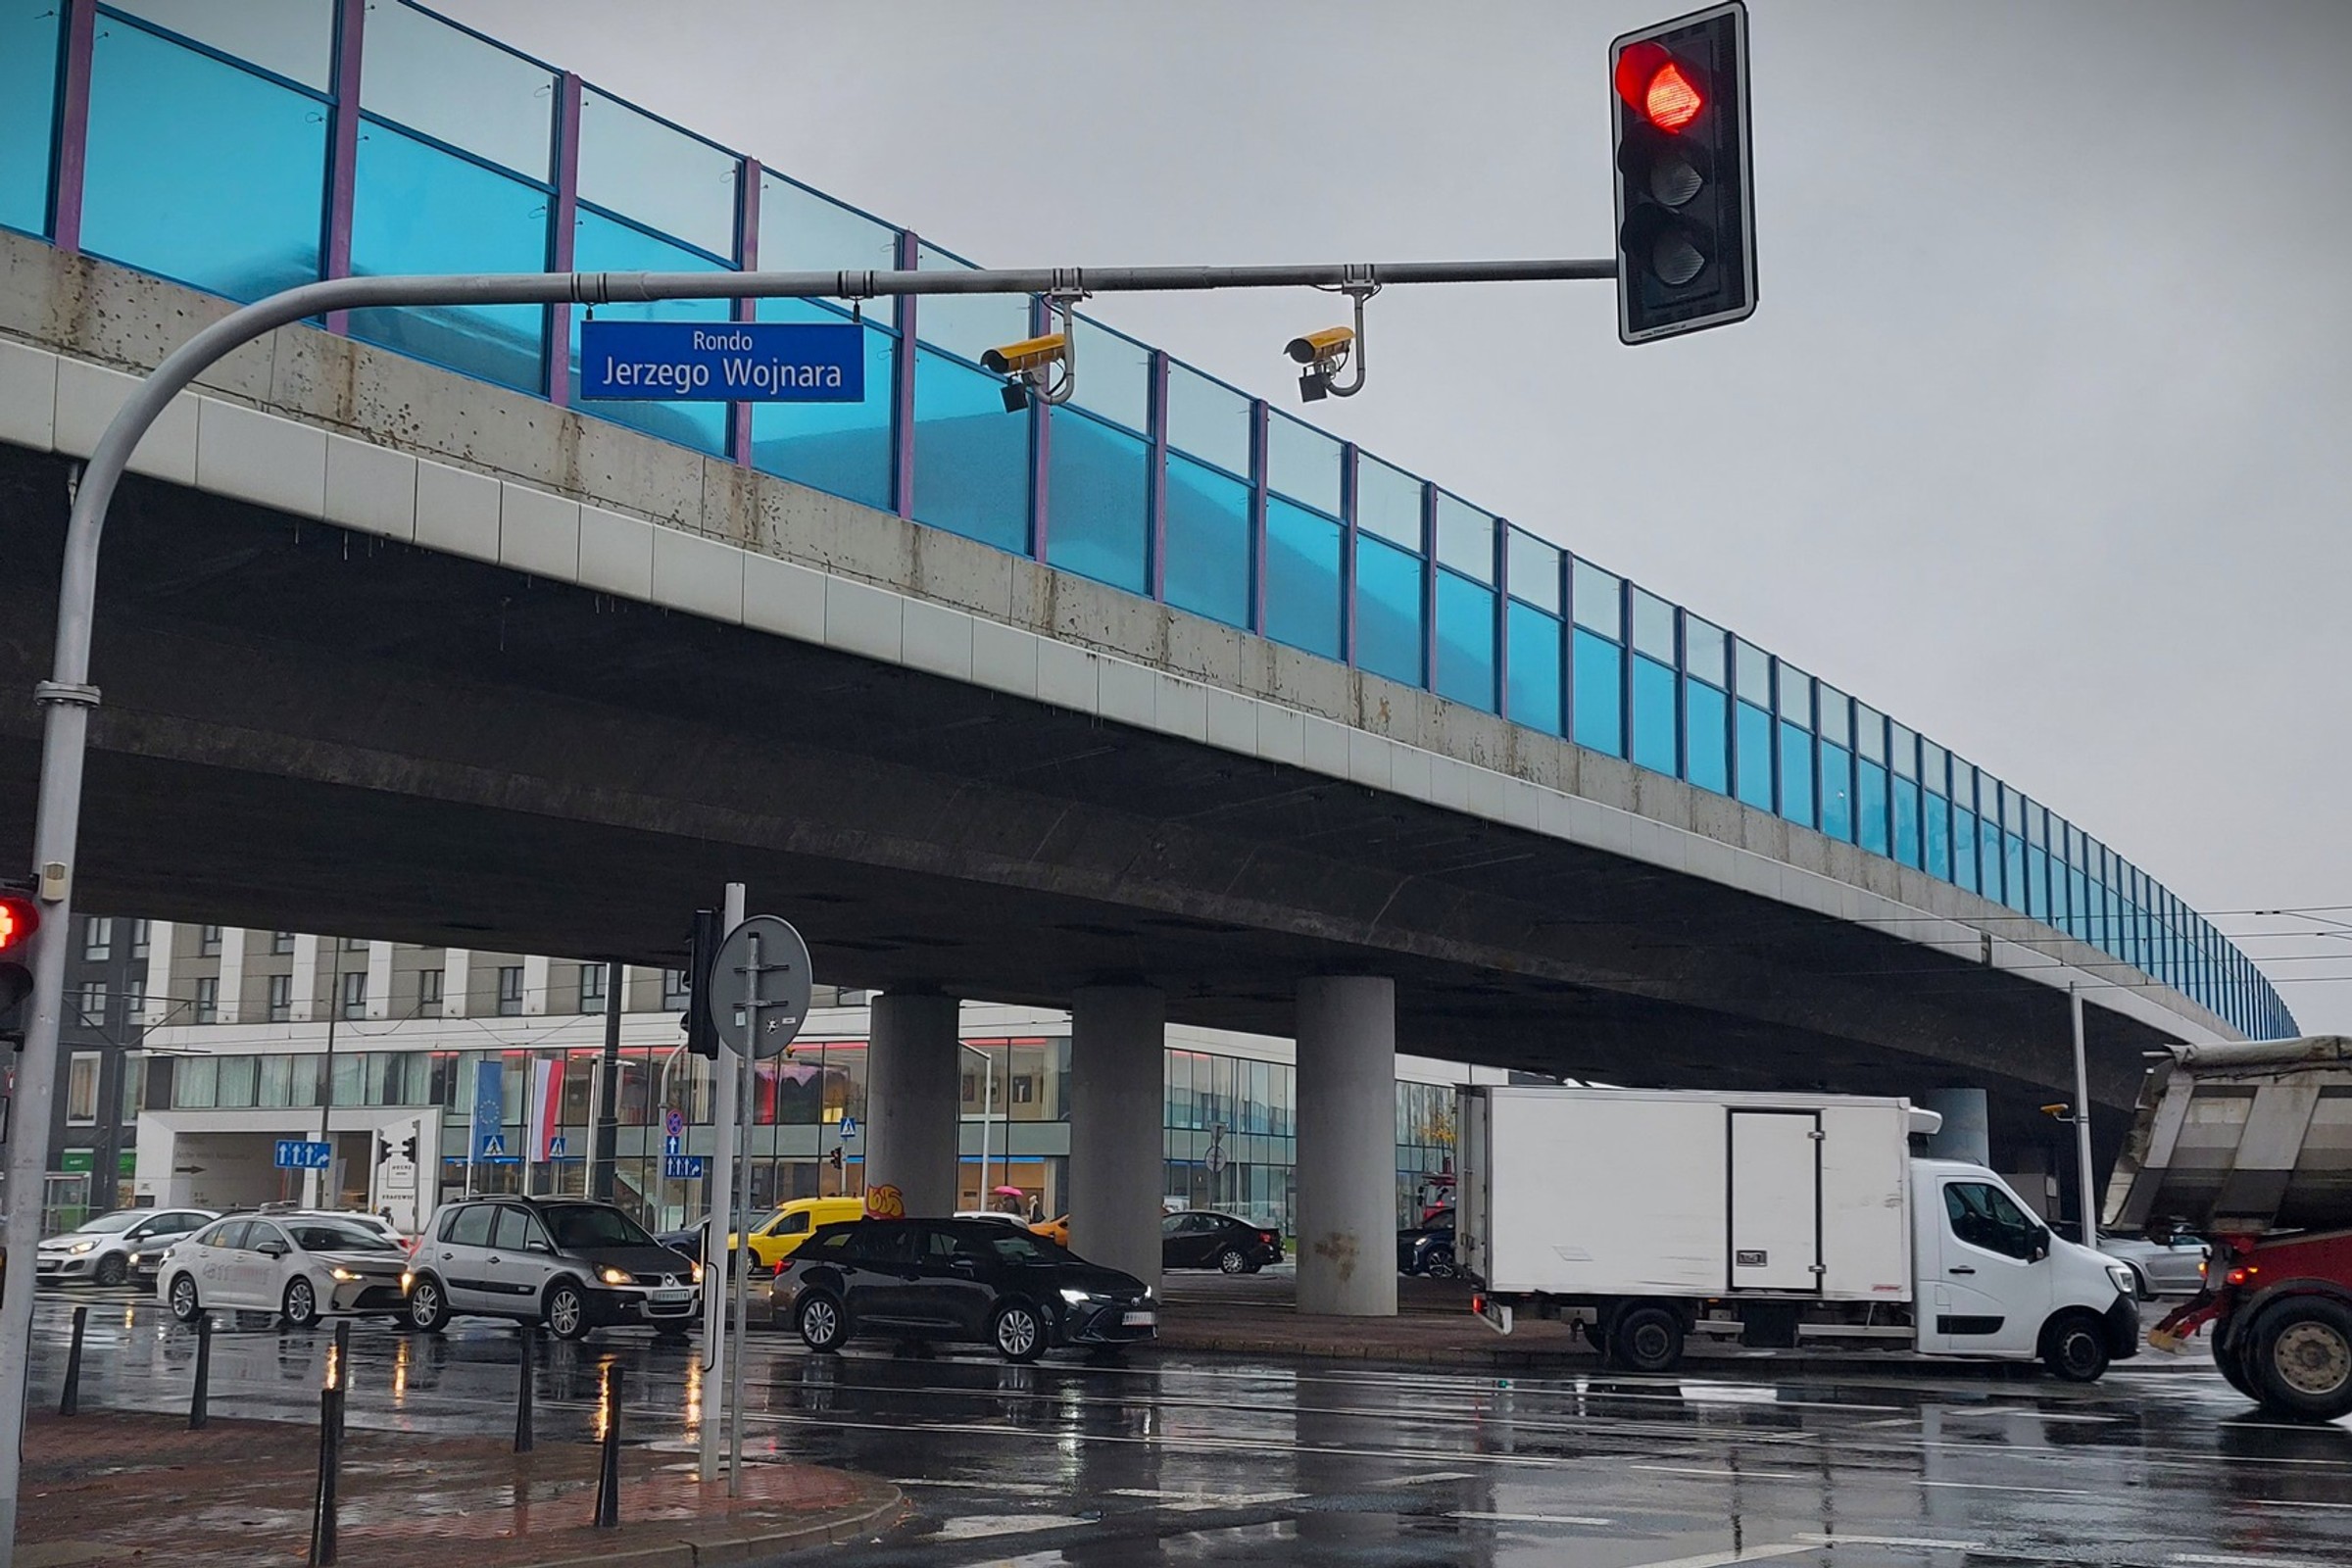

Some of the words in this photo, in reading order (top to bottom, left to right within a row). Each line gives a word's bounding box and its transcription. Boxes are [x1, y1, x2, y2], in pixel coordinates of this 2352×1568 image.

[693, 330, 753, 352] Rondo
[602, 356, 710, 394] Jerzego
[722, 358, 842, 395] Wojnara
